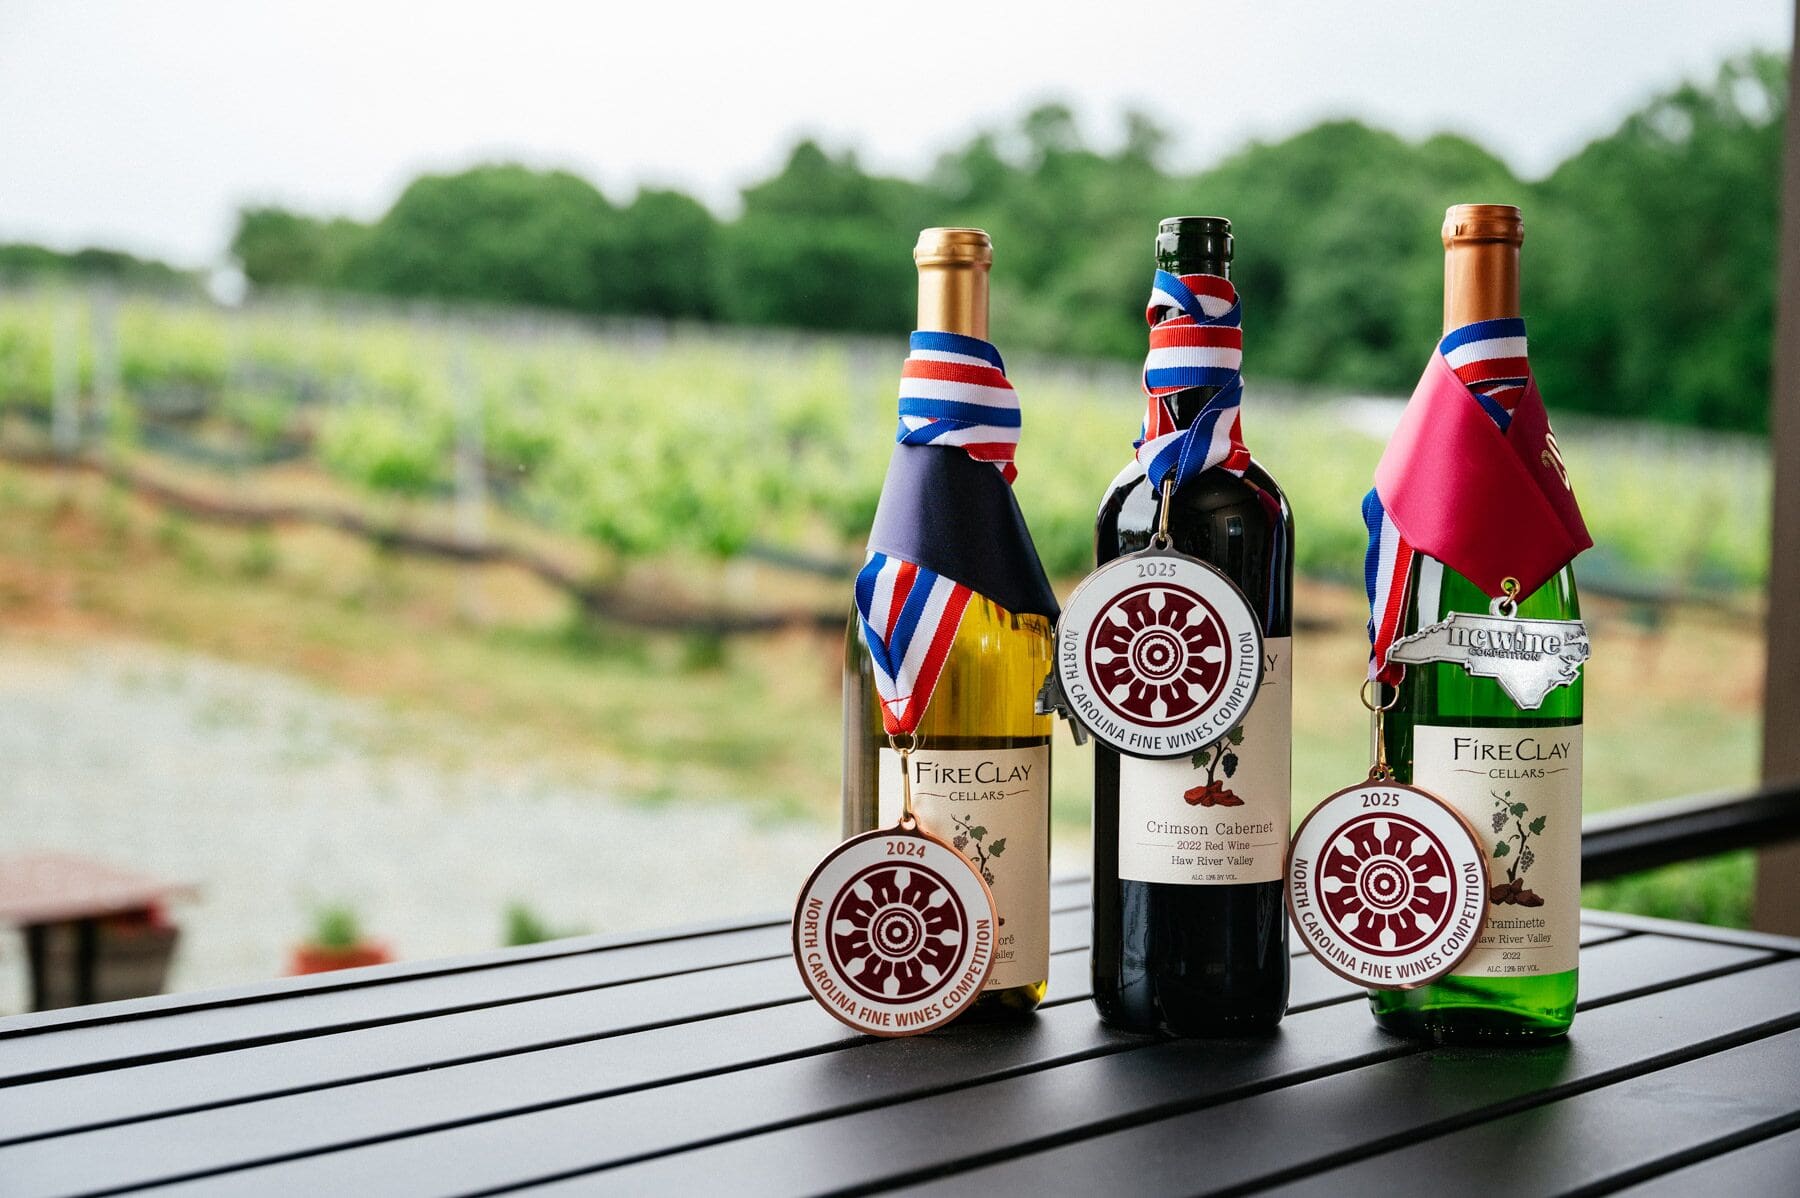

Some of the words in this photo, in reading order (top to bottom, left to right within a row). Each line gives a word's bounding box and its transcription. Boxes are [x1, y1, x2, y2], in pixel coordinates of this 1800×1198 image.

[1136, 562, 1177, 577] 2025
[1063, 628, 1080, 680] NORTH
[1468, 648, 1541, 661] COMPETITION
[1212, 631, 1254, 726] COMPETITION
[1070, 684, 1125, 742] CAROLINA
[1129, 732, 1162, 750] FINE
[1166, 722, 1213, 750] WINES
[1488, 768, 1545, 779] CELLARS
[948, 790, 1005, 801] CELLARS
[1360, 792, 1400, 808] 2025
[1146, 820, 1209, 835] Crimson
[1215, 822, 1273, 835] Cabernet
[886, 841, 926, 859] 2024
[1177, 841, 1202, 851] 2022
[1205, 841, 1224, 851] Red
[1228, 841, 1250, 850] Wine
[1171, 856, 1194, 865] Haw
[1197, 856, 1223, 866] River
[1226, 855, 1254, 866] Valley
[803, 898, 823, 949] NORTH
[1293, 858, 1310, 908] NORTH
[1302, 912, 1357, 971] CAROLINA
[1360, 961, 1392, 979] FINE
[1396, 952, 1442, 979] WINES
[1441, 861, 1480, 957] COMPETITION
[1479, 934, 1495, 943] aw
[1499, 934, 1524, 944] River
[1527, 933, 1552, 943] Valley
[942, 918, 990, 1010] COMPETITION
[995, 950, 1015, 960] alley
[1502, 951, 1521, 960] 2022
[808, 952, 857, 1016] CAROLINA
[858, 1006, 890, 1027] FINE
[895, 1006, 942, 1028] WINES
